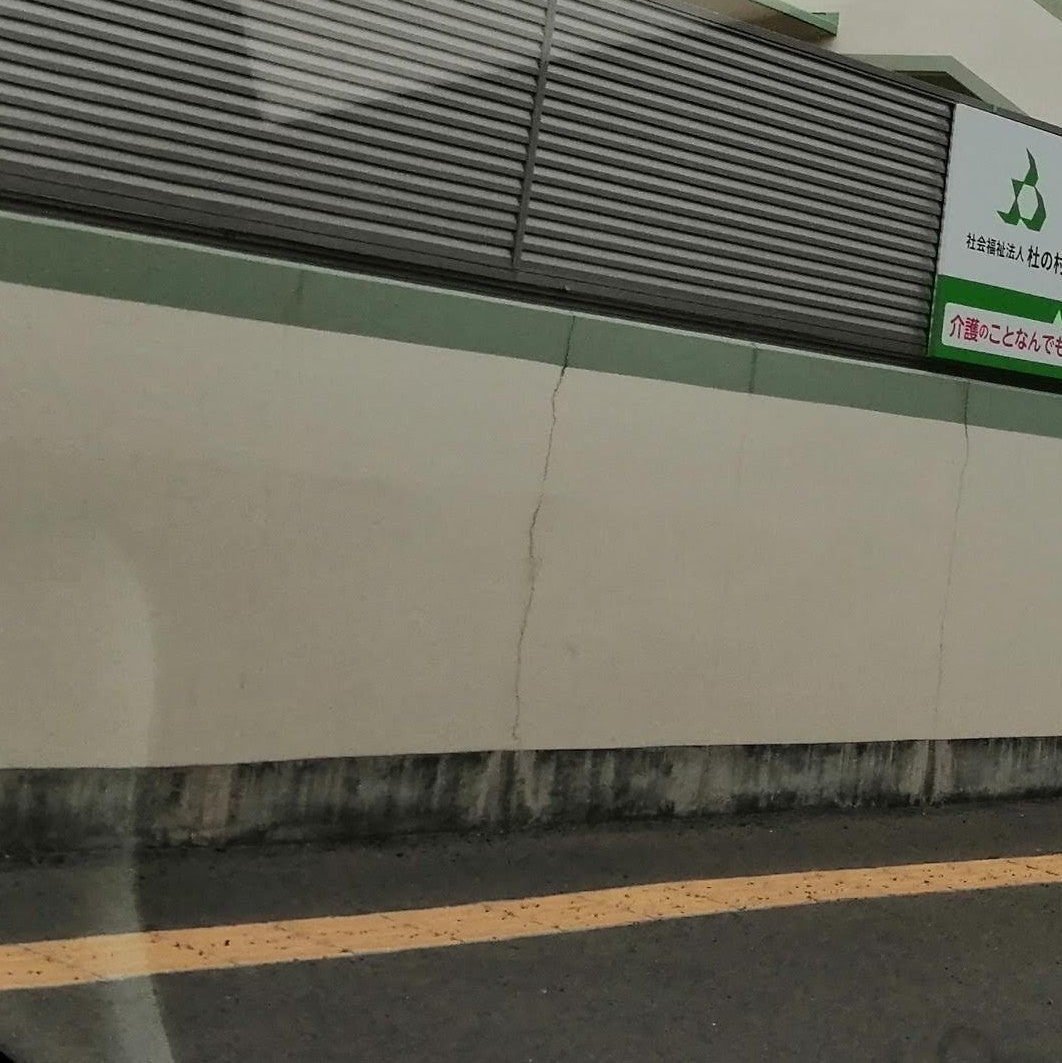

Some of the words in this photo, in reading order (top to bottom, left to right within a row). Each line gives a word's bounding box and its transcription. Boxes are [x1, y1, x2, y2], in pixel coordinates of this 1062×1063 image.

[966, 232, 1024, 263] 社会福祉法人
